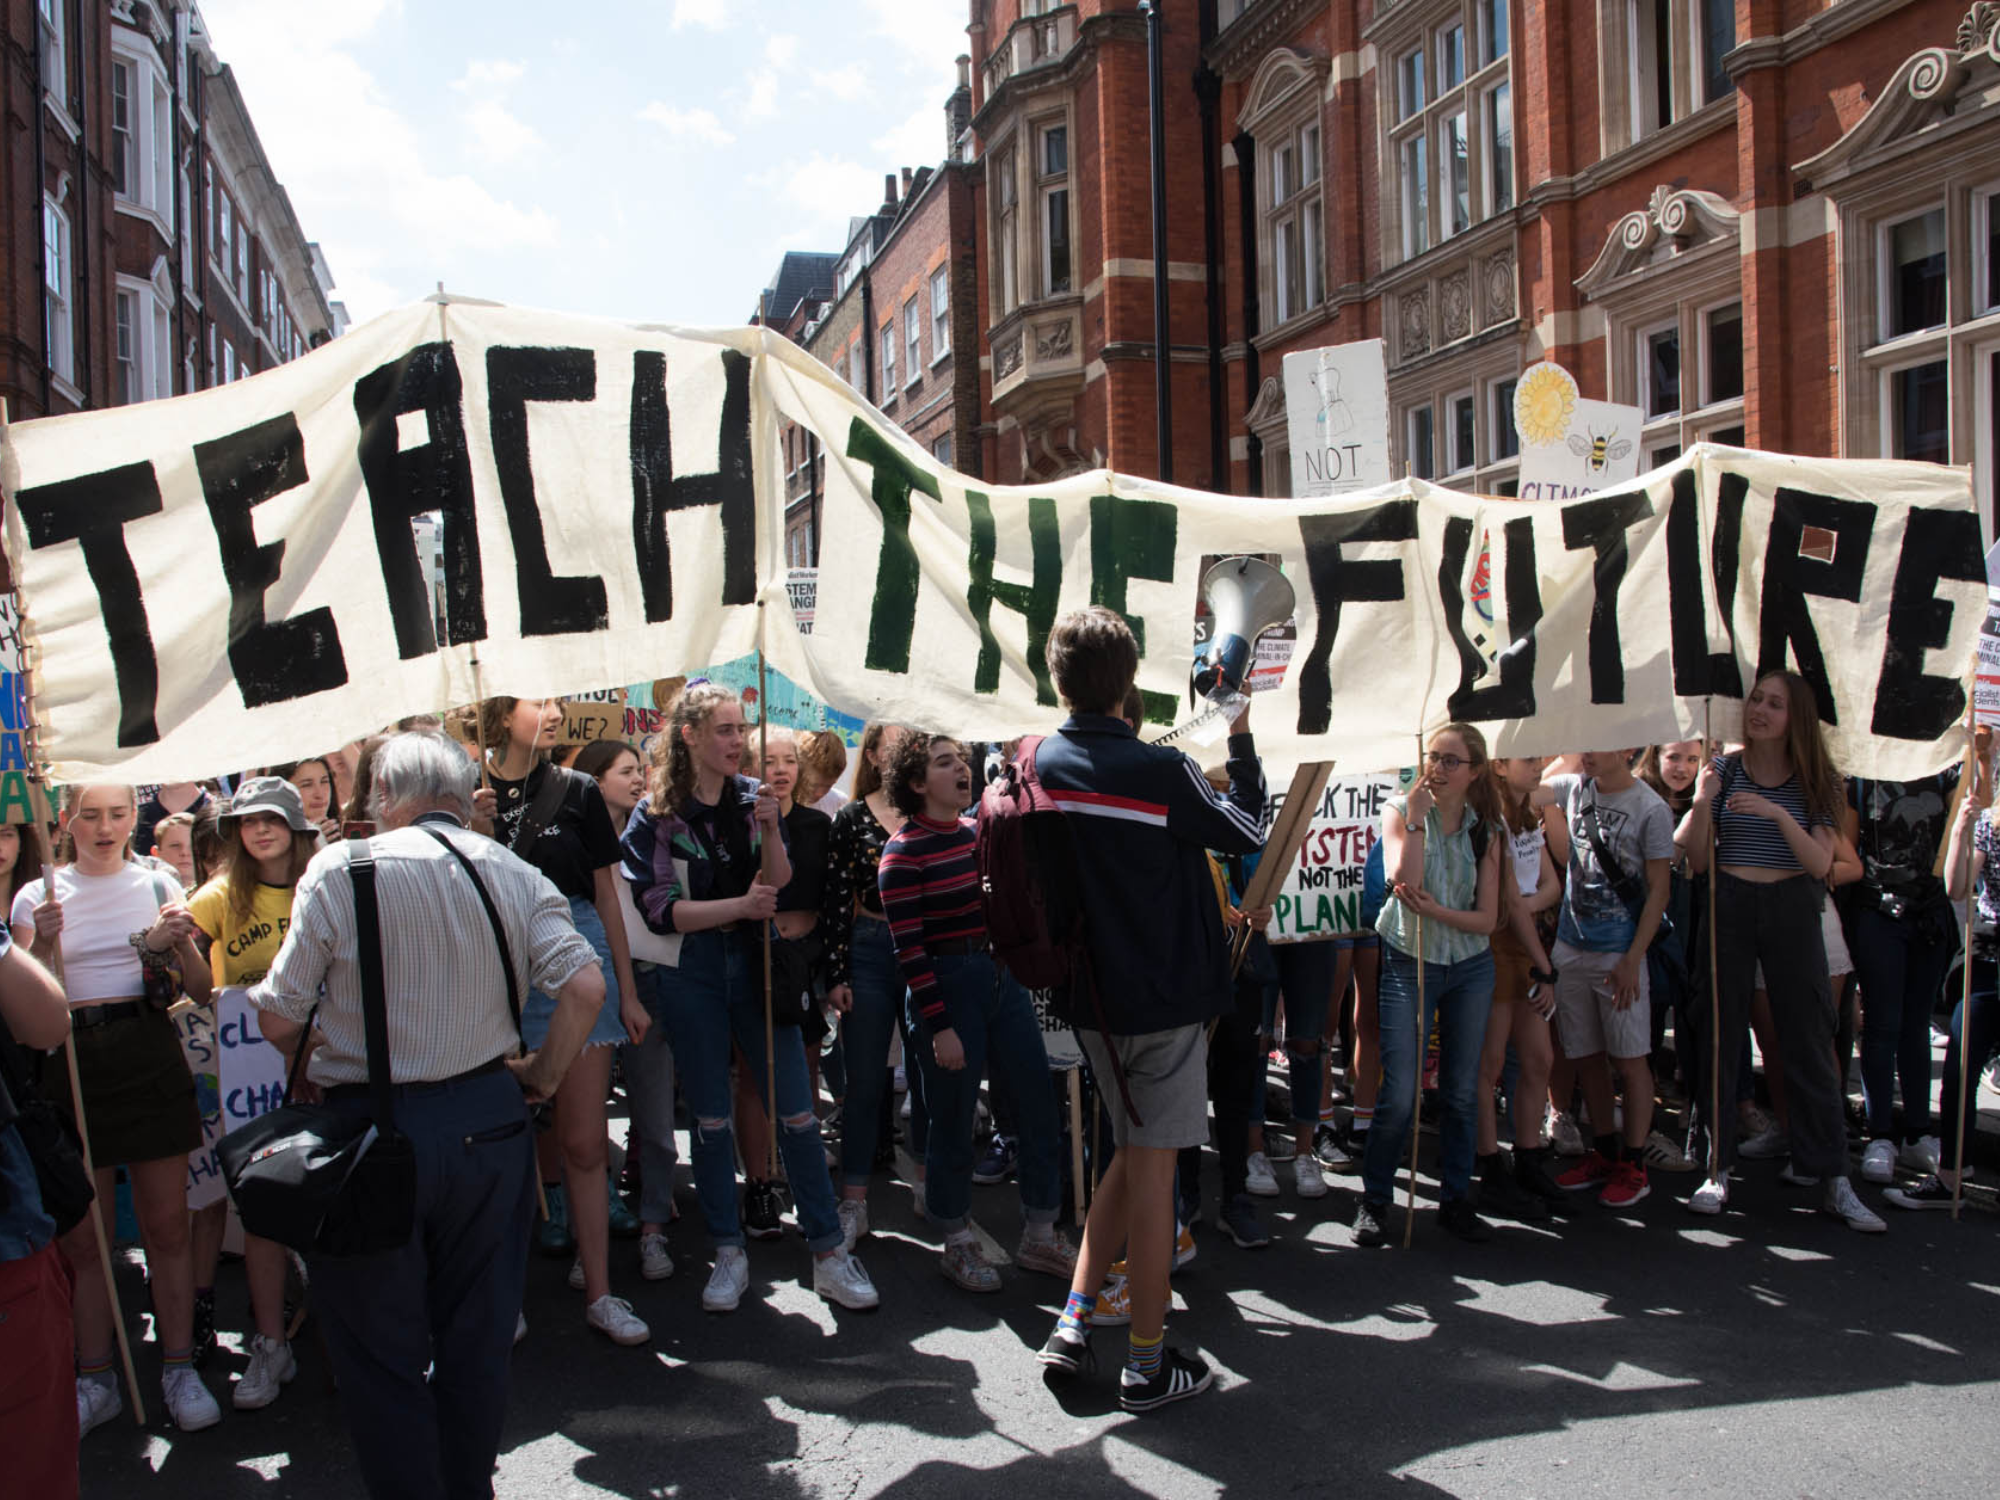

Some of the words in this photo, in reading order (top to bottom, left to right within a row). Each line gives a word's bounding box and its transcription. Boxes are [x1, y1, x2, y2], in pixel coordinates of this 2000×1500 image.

[1305, 443, 1362, 482] NOT
[13, 340, 757, 748] TEACH
[846, 415, 1181, 727] THE
[1297, 467, 1988, 740] FUTURE
[1270, 783, 1341, 824] FK
[1344, 783, 1393, 819] THE
[1299, 867, 1333, 891] NOT
[1334, 866, 1363, 889] THE
[1275, 891, 1364, 934] PLAN
[226, 923, 272, 957] CAMP
